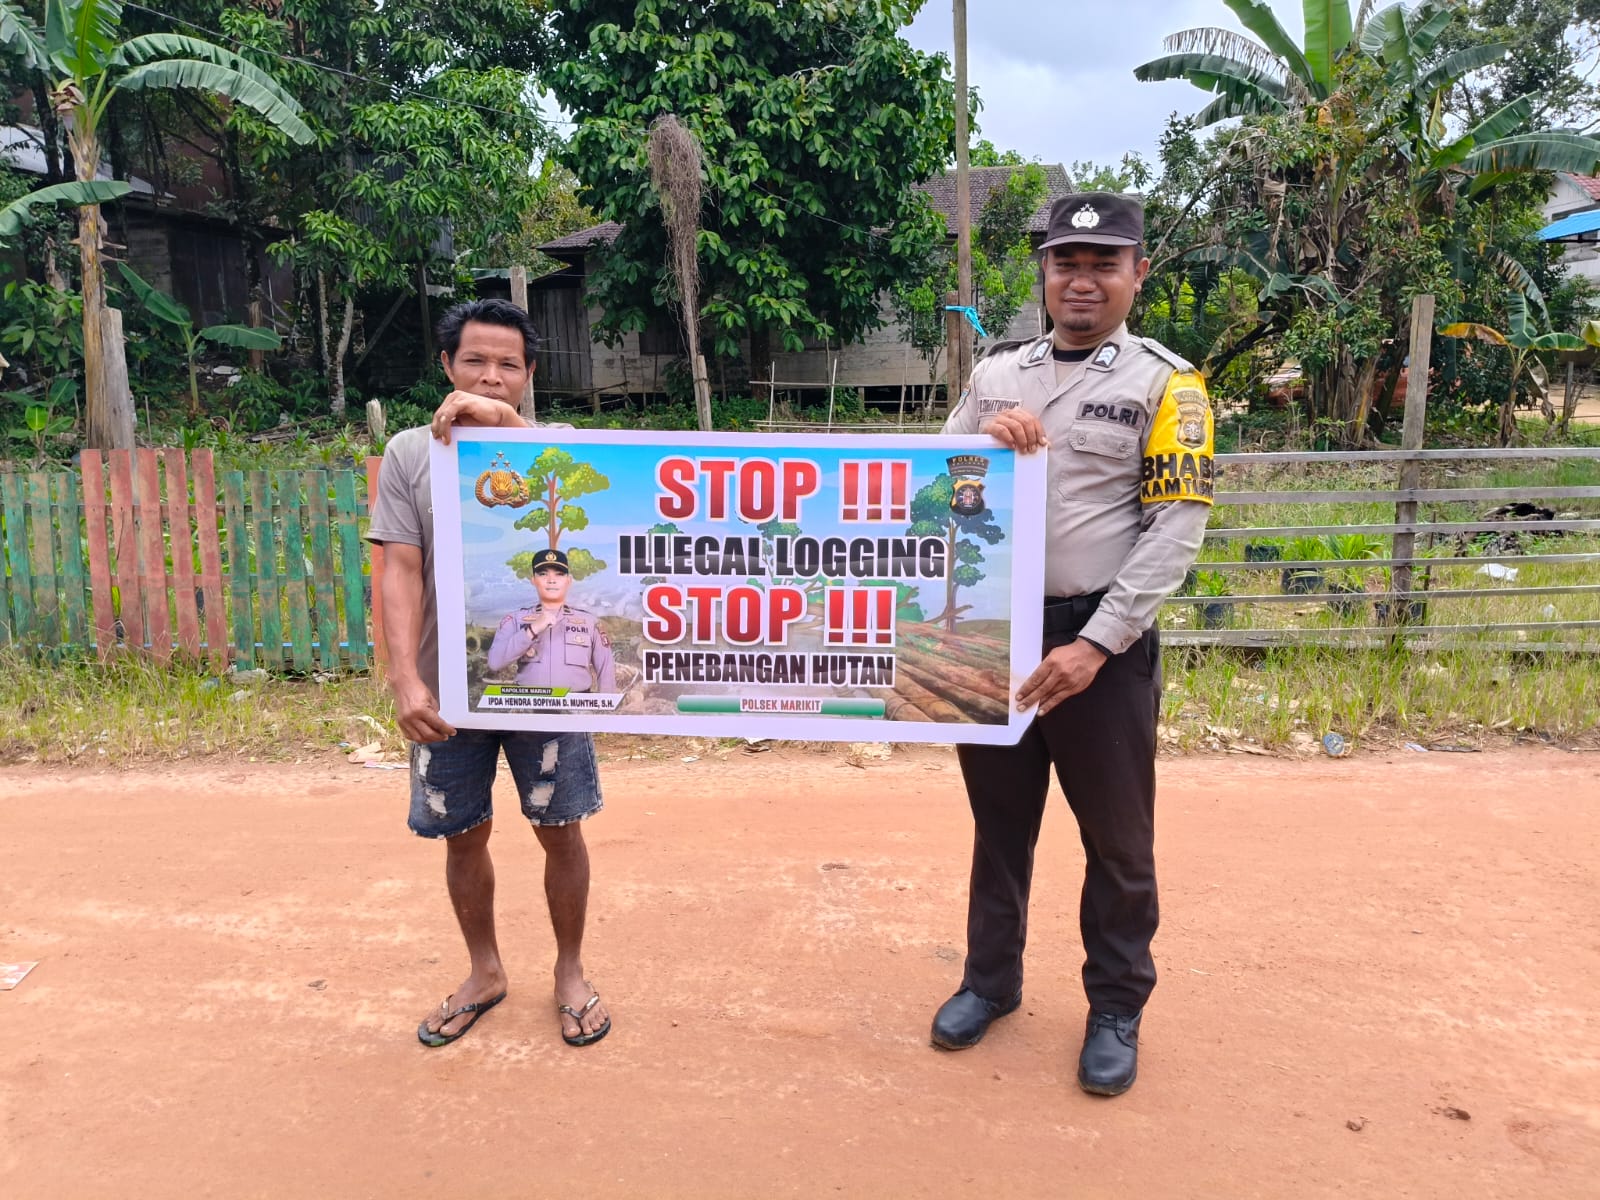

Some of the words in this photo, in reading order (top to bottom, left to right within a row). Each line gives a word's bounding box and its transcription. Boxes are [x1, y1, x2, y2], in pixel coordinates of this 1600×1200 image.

[1081, 403, 1140, 427] POLRI
[658, 458, 820, 521] STOP
[842, 460, 911, 522] !!!
[619, 534, 765, 576] ILLEGAL
[781, 537, 946, 579] LOGGING
[565, 625, 589, 634] POLRI
[645, 587, 805, 645] STOP
[828, 588, 894, 646] !!!
[644, 653, 808, 685] PENEBANGAN
[812, 654, 894, 687] HUTAN
[488, 698, 503, 706] IPDA
[504, 698, 532, 707] HENDRA
[533, 699, 562, 707] SOPIYAN
[562, 699, 570, 708] D.
[570, 699, 600, 709] MUNTHE,
[601, 700, 615, 708] S.H.
[741, 698, 778, 711] POLSEK
[780, 699, 822, 712] MARIKIT
